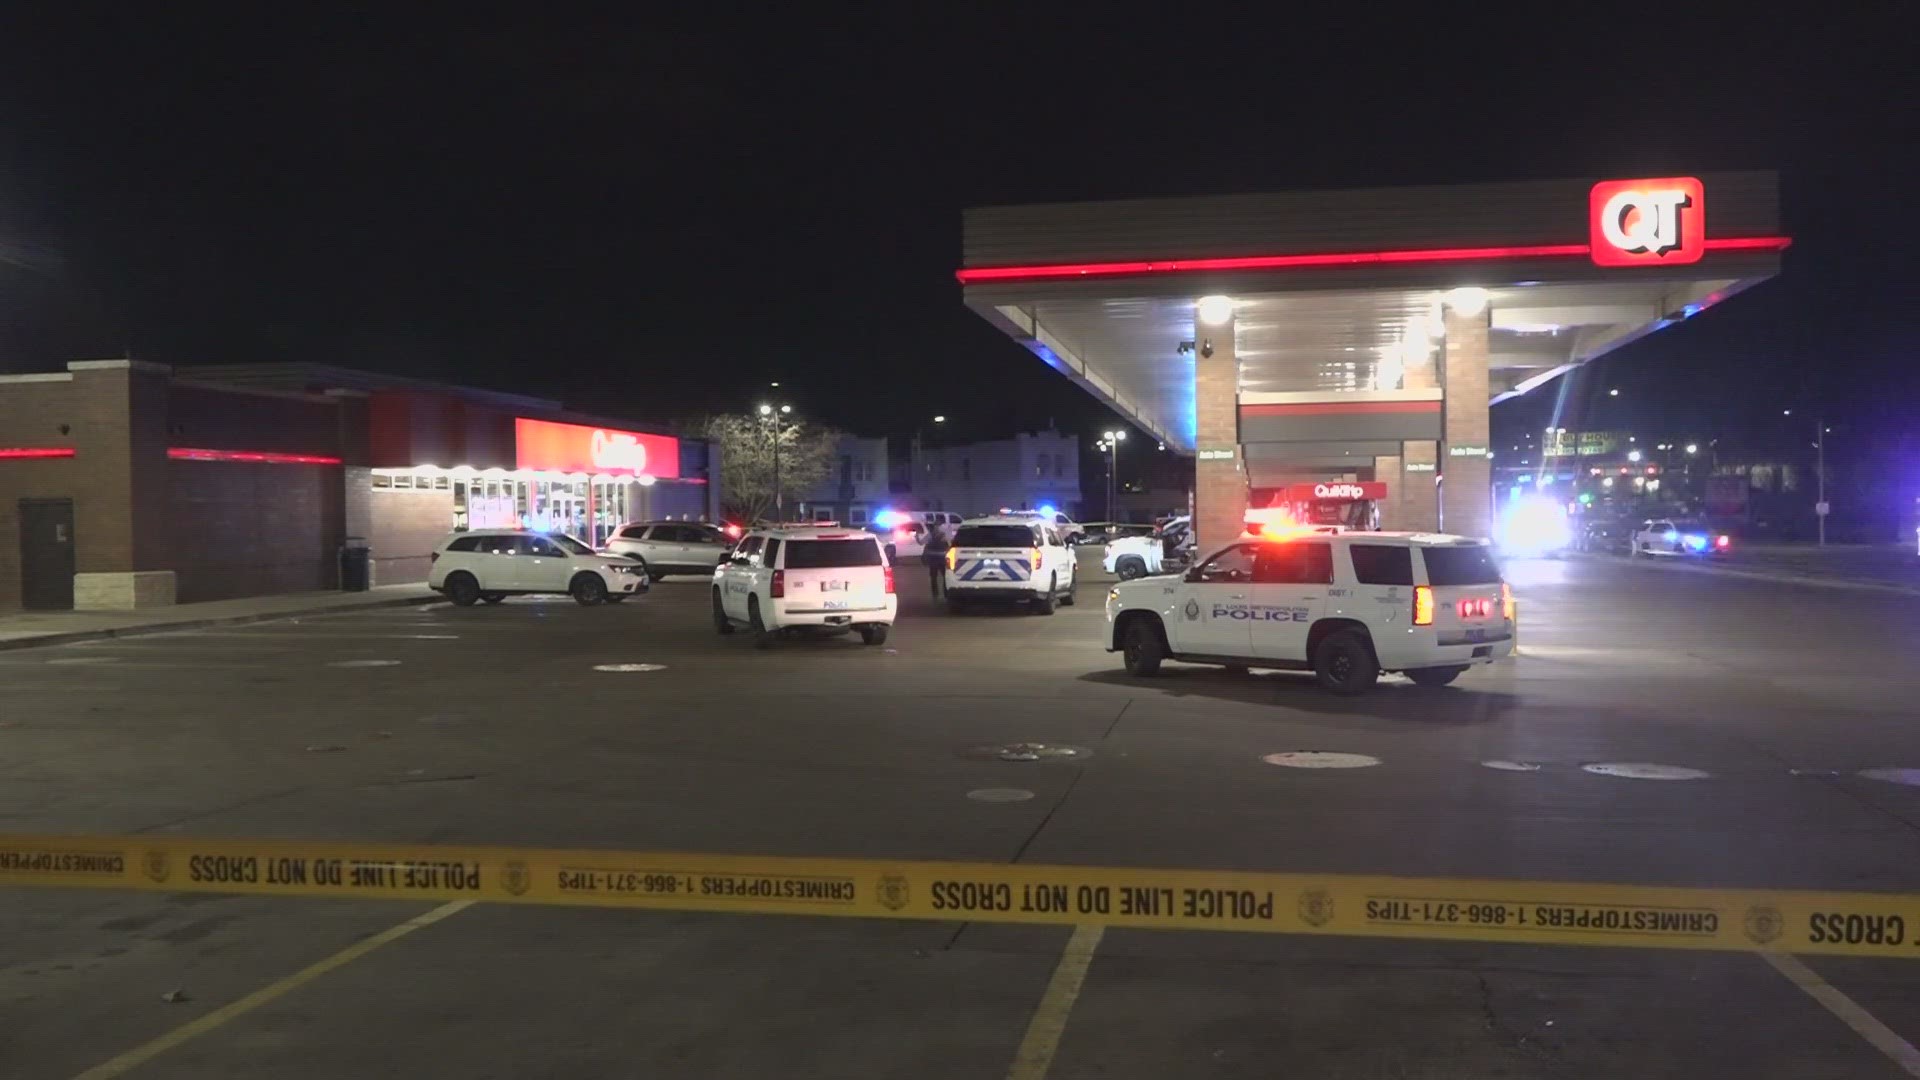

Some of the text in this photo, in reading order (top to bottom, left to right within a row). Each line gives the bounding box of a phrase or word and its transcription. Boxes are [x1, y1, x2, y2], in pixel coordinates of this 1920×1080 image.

[1602, 190, 1689, 256] QT
[1212, 609, 1309, 622] POLICE
[189, 854, 480, 891] POLICE LINE DO NOT CROSS
[700, 874, 855, 901] CRIMESTOPPERS
[931, 881, 1274, 920] POLICE LINE DO NOT CROSS
[1366, 899, 1719, 933] CRIMESTOPPERS 1-866-371-TIPS
[1809, 913, 1905, 946] CROSS
